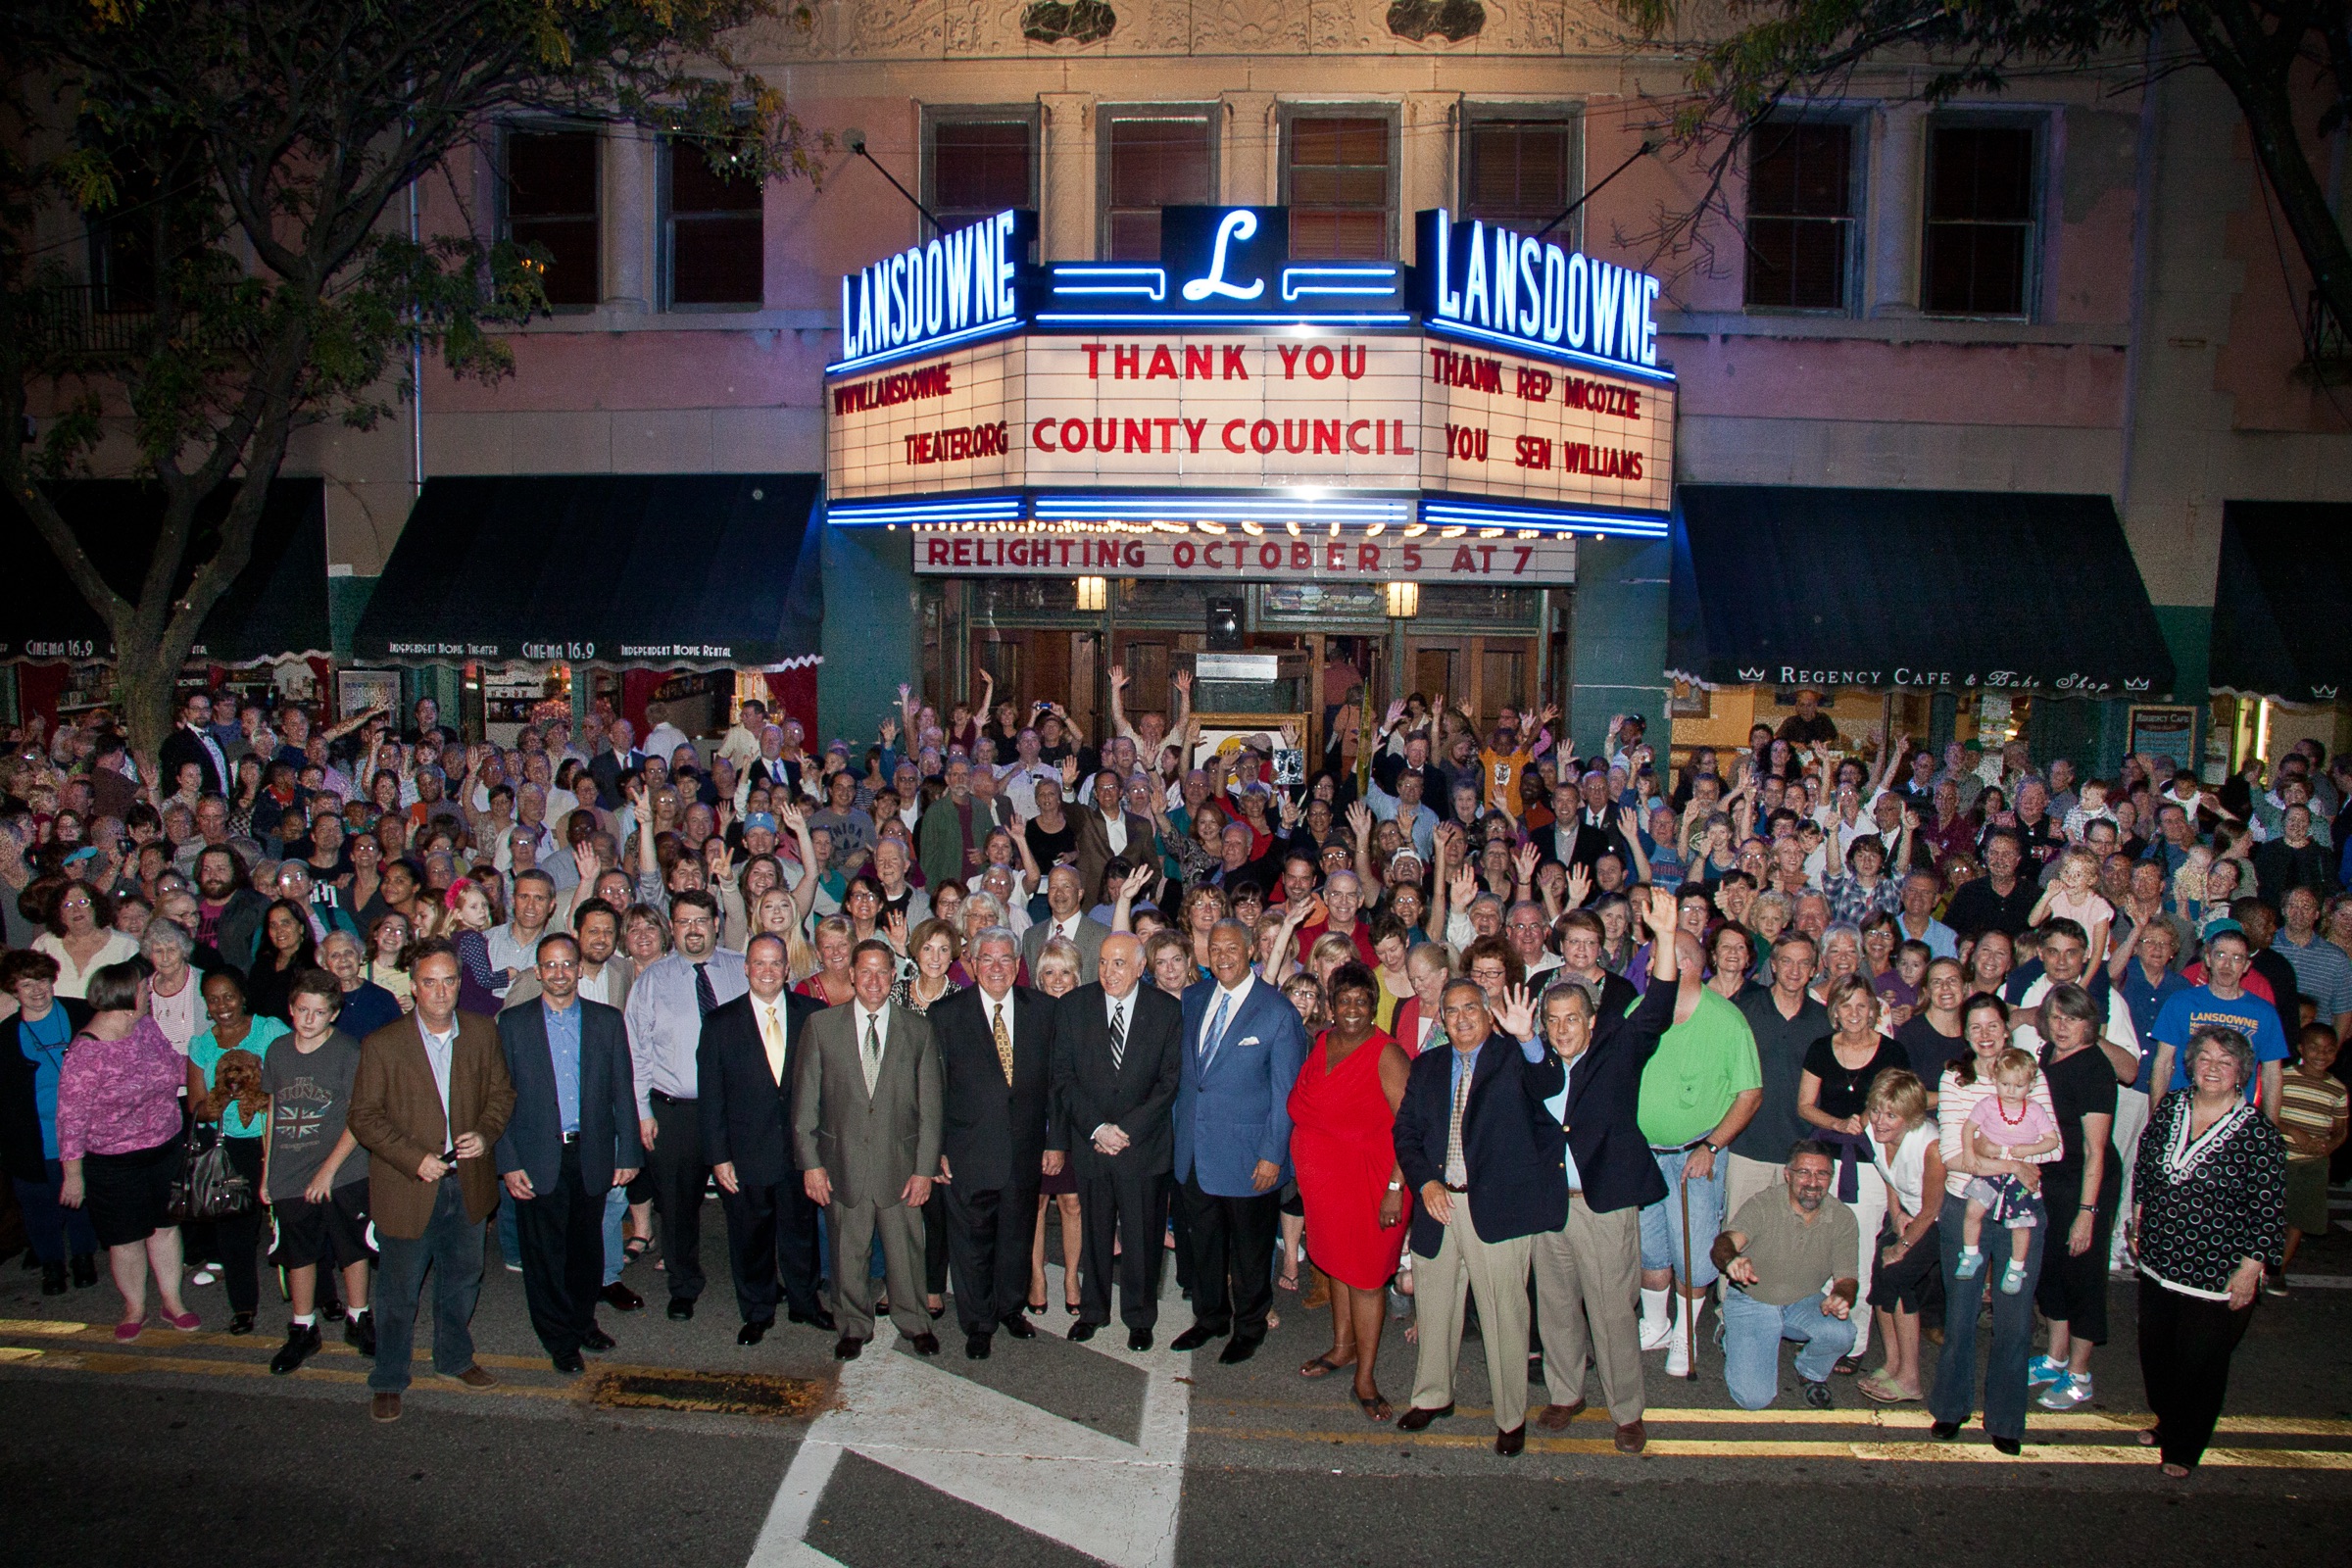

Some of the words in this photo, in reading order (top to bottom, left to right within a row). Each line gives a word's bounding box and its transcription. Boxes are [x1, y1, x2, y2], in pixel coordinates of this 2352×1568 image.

[1182, 209, 1265, 301] L
[843, 209, 1015, 360] LANSDOWNE
[1438, 208, 1661, 367] LANSDOWNE
[1081, 343, 1250, 381] THANK
[1277, 344, 1367, 381] YOU
[1430, 347, 1504, 395] THANK
[1516, 366, 1553, 403] REP
[1564, 375, 1642, 420] MICOZZIE
[1032, 416, 1208, 455] COUNTY
[1221, 417, 1415, 456] COUNCIL
[1444, 422, 1489, 464] YOU
[1514, 435, 1553, 471] SEN
[1564, 440, 1644, 482] WILLIAMS
[927, 537, 1146, 568] RELIGHTING
[1172, 540, 1382, 572] OCTOBER
[1402, 542, 1422, 572] 5
[1451, 544, 1498, 573] AT
[1512, 545, 1535, 575] 7
[1965, 673, 1976, 686] &
[2056, 672, 2111, 694] Shop
[2189, 1011, 2259, 1030] LANSDOWNE
